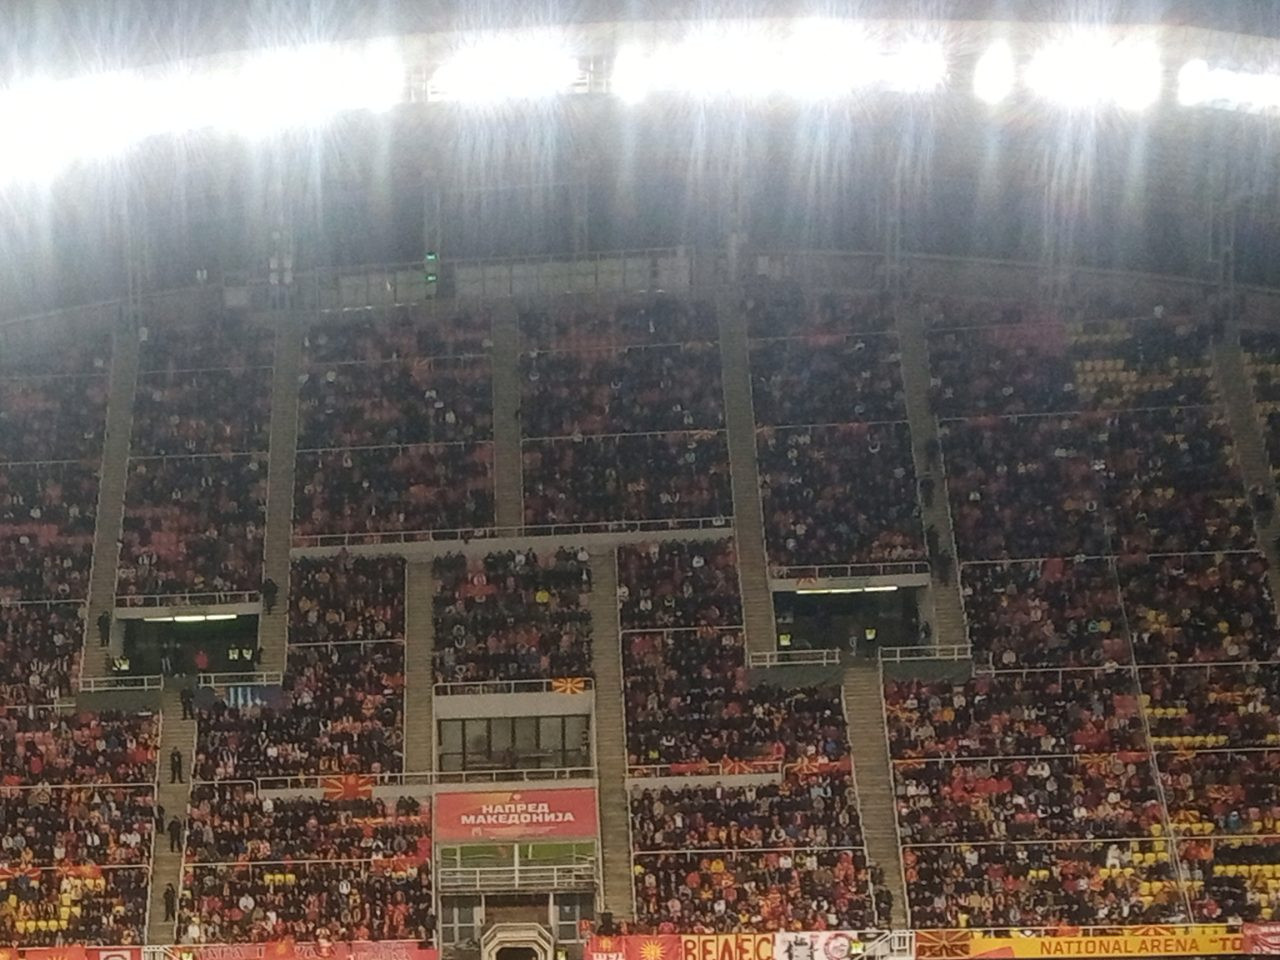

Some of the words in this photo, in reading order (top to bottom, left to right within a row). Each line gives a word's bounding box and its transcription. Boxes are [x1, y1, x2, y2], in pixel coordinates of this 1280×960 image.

[482, 802, 549, 815] НАПРЕД
[460, 812, 575, 825] МАКЕДОНИЈА
[1040, 938, 1132, 955] NATIONAL
[1138, 938, 1200, 953] ARENA
